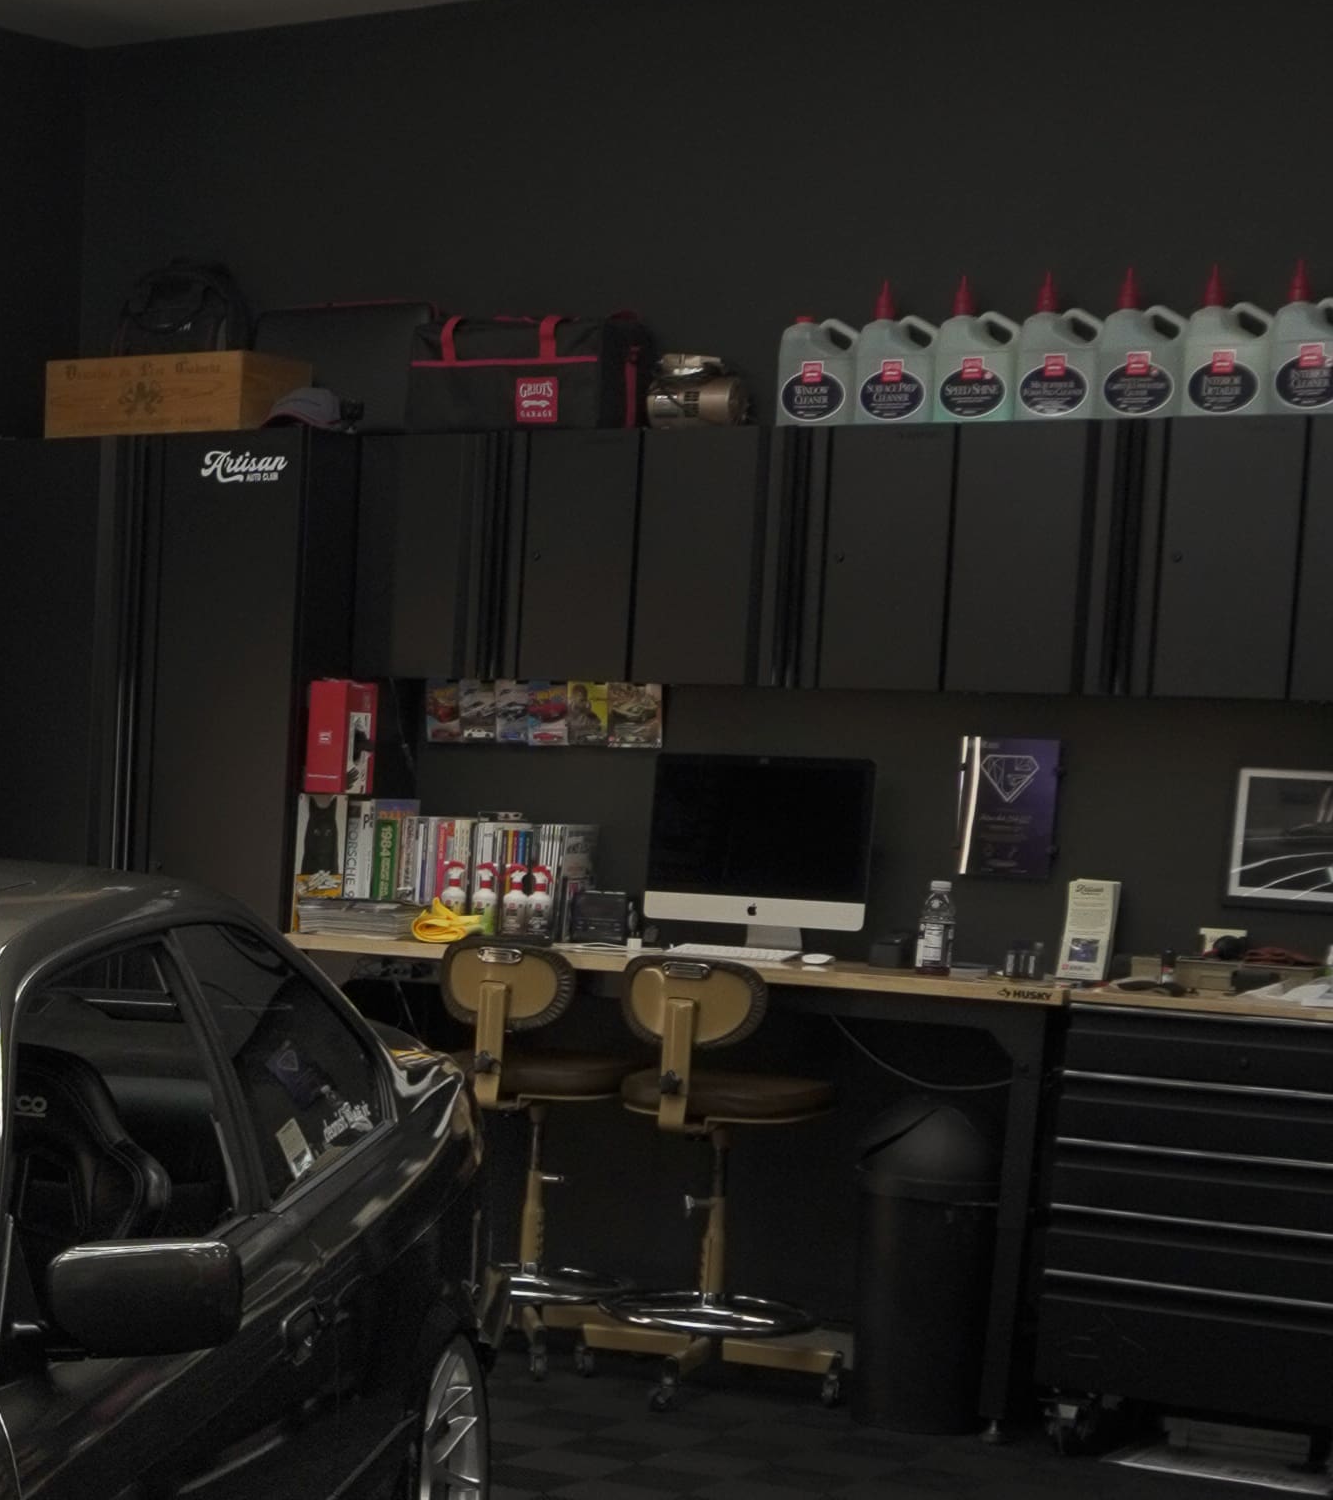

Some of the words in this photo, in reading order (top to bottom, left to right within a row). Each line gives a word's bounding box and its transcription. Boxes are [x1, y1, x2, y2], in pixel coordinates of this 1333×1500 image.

[201, 450, 288, 483] Artisan
[379, 825, 393, 857] 1984
[1012, 990, 1053, 1001] HUSKY
